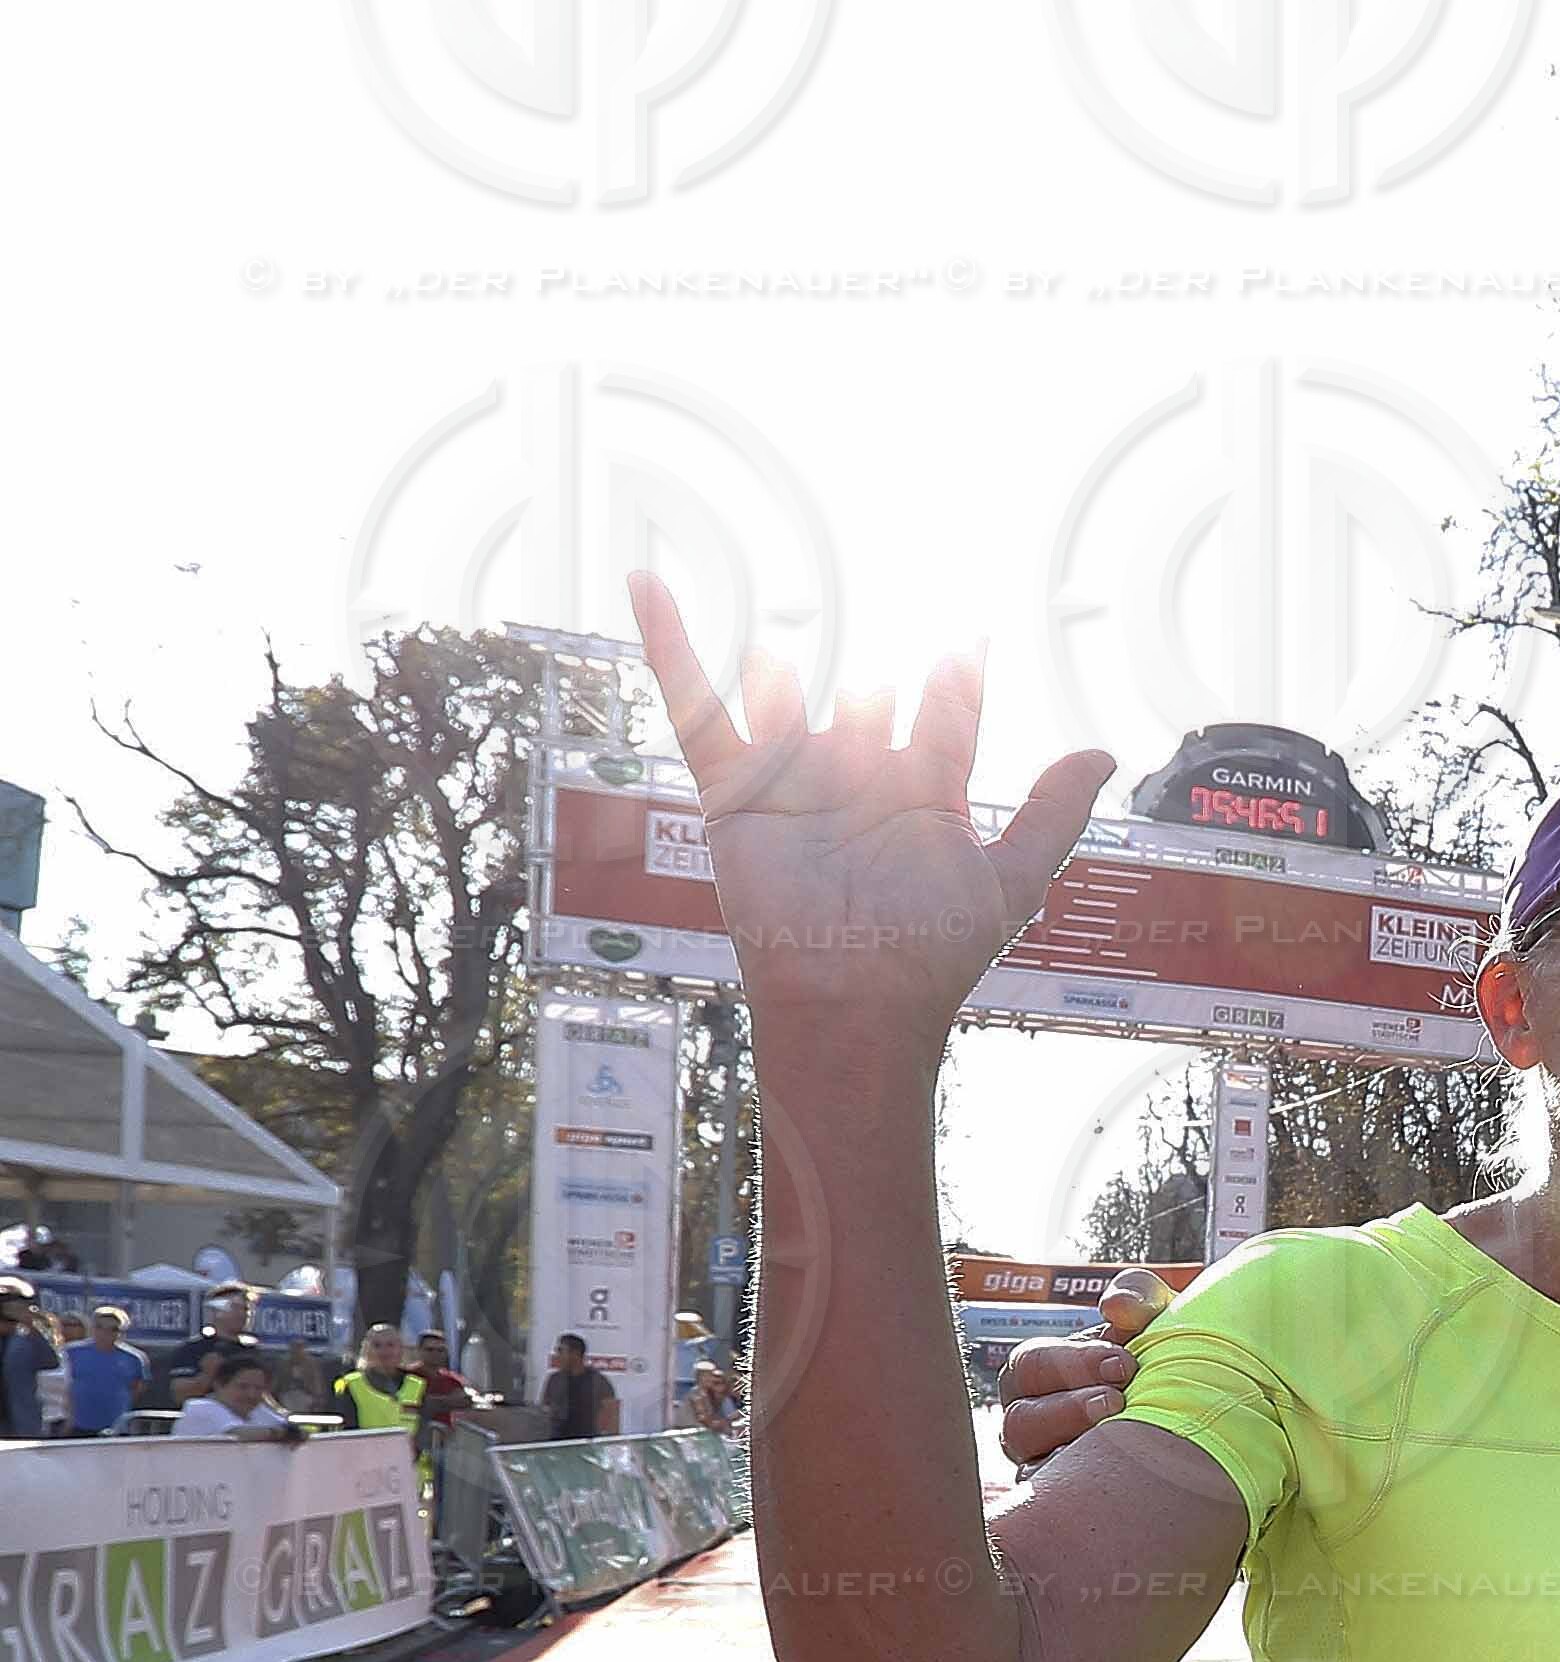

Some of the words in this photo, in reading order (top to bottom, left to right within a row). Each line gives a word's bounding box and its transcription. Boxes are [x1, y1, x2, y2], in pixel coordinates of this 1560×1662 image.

[1211, 766, 1312, 796] GARMIN
[1377, 911, 1471, 941] KLEINE
[1375, 935, 1472, 968] ZEITUNG
[1213, 1006, 1284, 1029] GRAZ
[984, 1272, 1046, 1296] giga
[1053, 1276, 1109, 1297] spo
[126, 1482, 232, 1528] HOLDING
[268, 1518, 410, 1624] GRAZ
